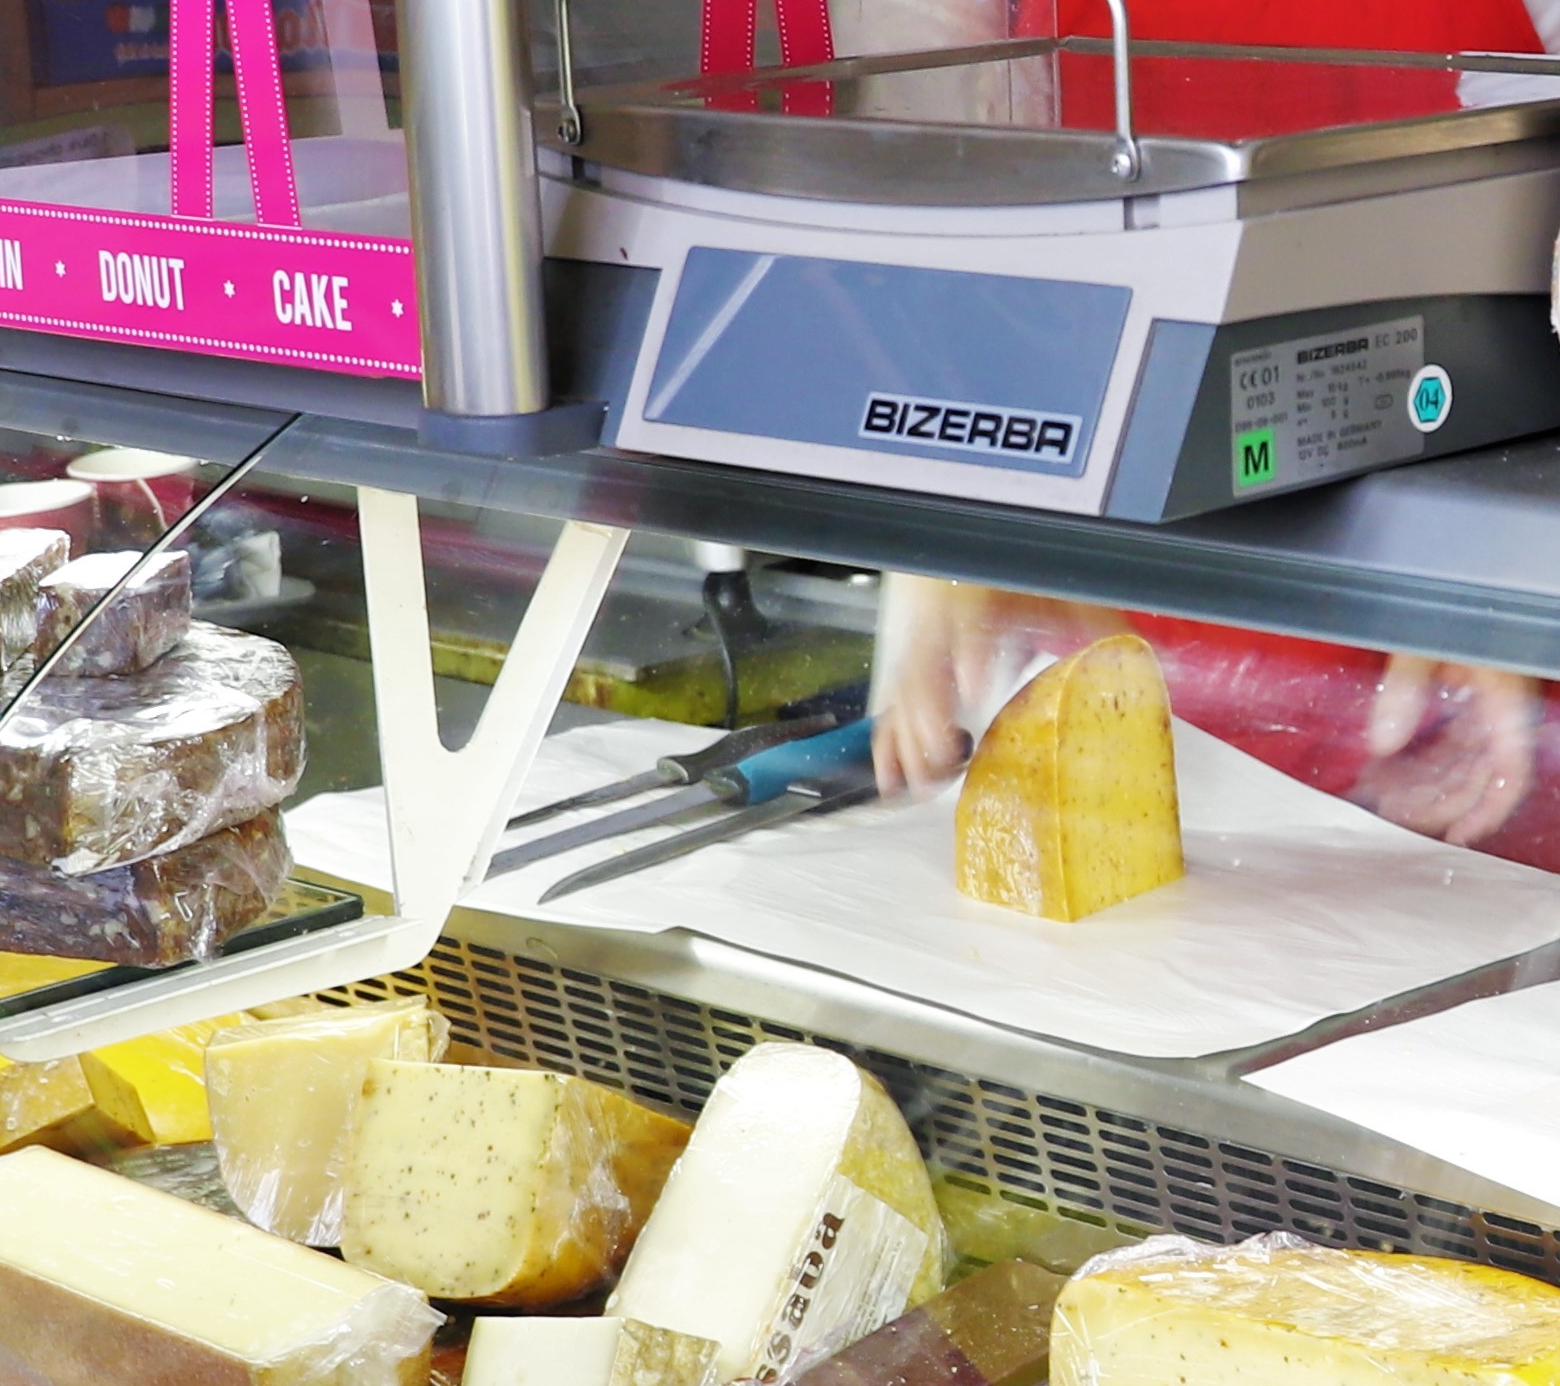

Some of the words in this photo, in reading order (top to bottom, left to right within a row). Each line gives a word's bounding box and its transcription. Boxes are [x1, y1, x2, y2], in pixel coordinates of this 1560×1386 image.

[100, 249, 186, 311] DONUT
[273, 269, 352, 332] CAKE
[1297, 338, 1369, 364] BIZERBA
[1375, 333, 1390, 349] EC
[1395, 327, 1418, 347] 200
[1419, 393, 1439, 411] 04
[864, 399, 1072, 456] BIZERBA
[1243, 441, 1269, 477] M
